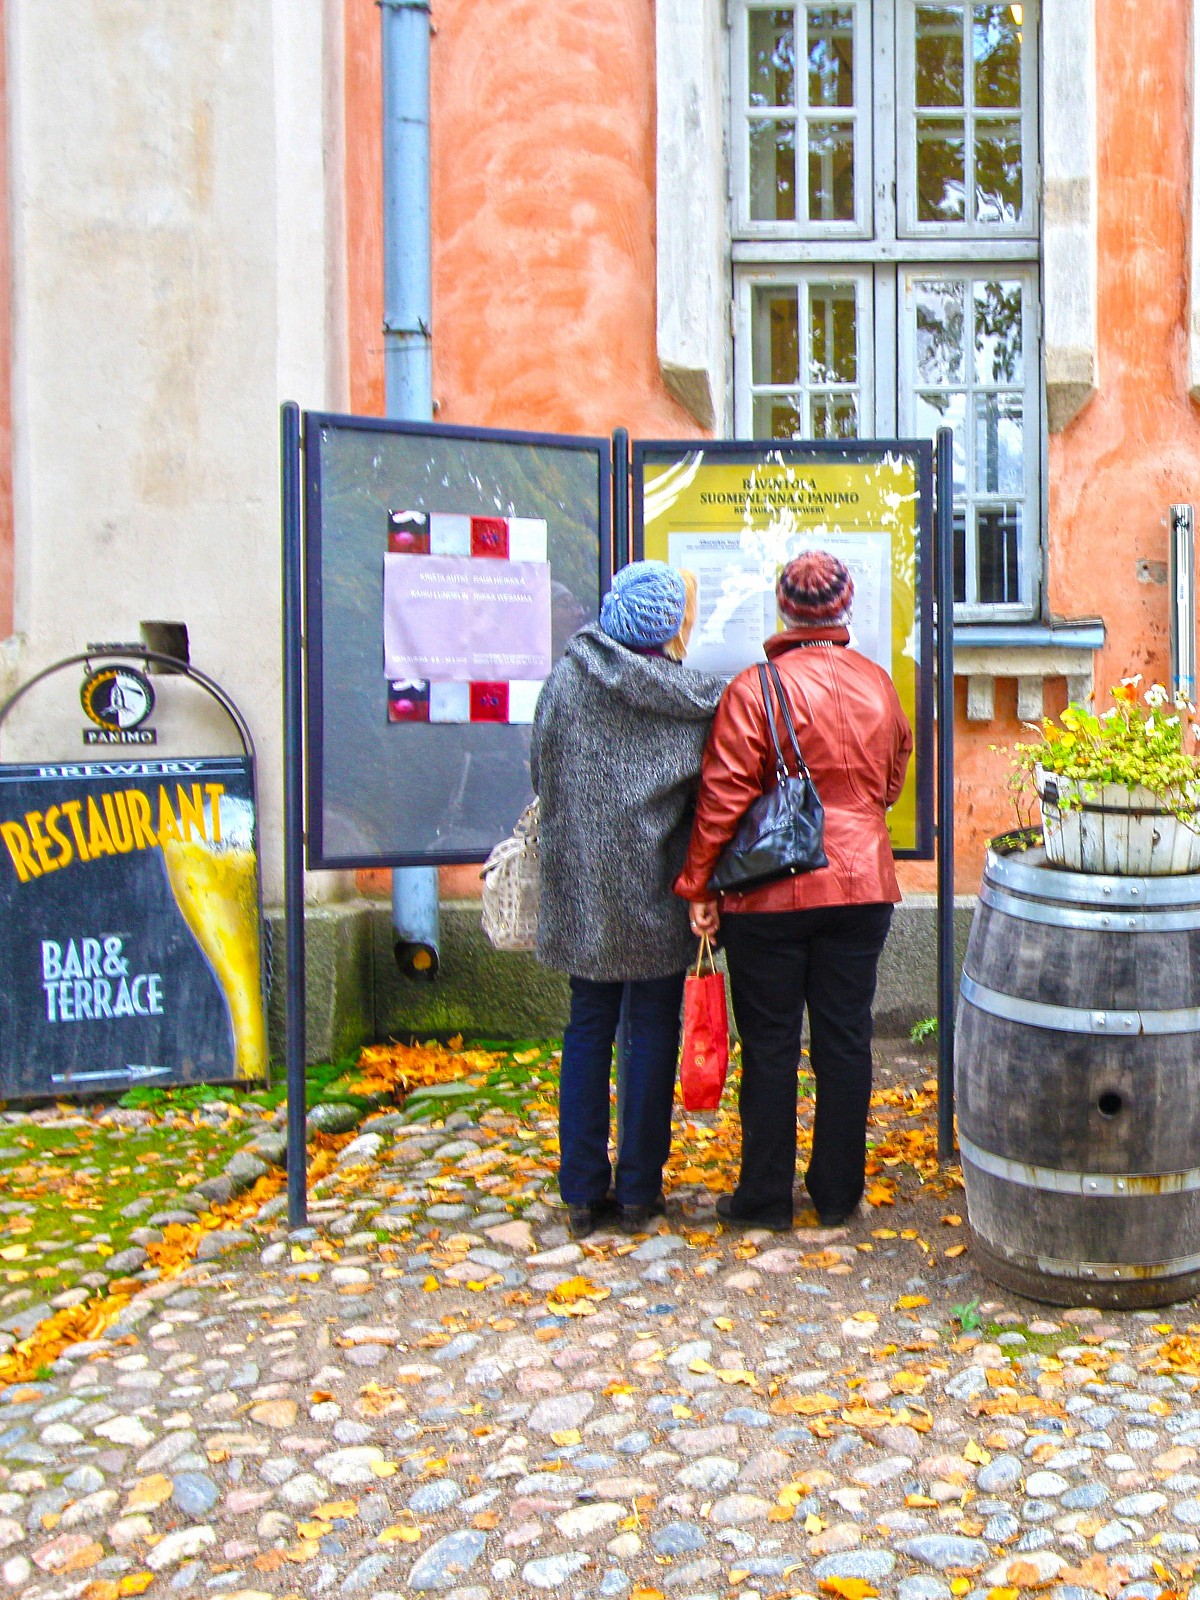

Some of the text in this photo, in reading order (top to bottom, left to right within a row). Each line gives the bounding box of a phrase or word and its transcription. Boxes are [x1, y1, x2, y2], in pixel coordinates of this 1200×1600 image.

[808, 492, 860, 505] PANIMO
[87, 730, 153, 744] PANIMO
[37, 761, 204, 778] BREWERY
[0, 783, 225, 884] RESTAURANT
[42, 973, 164, 1024] TERRACE
